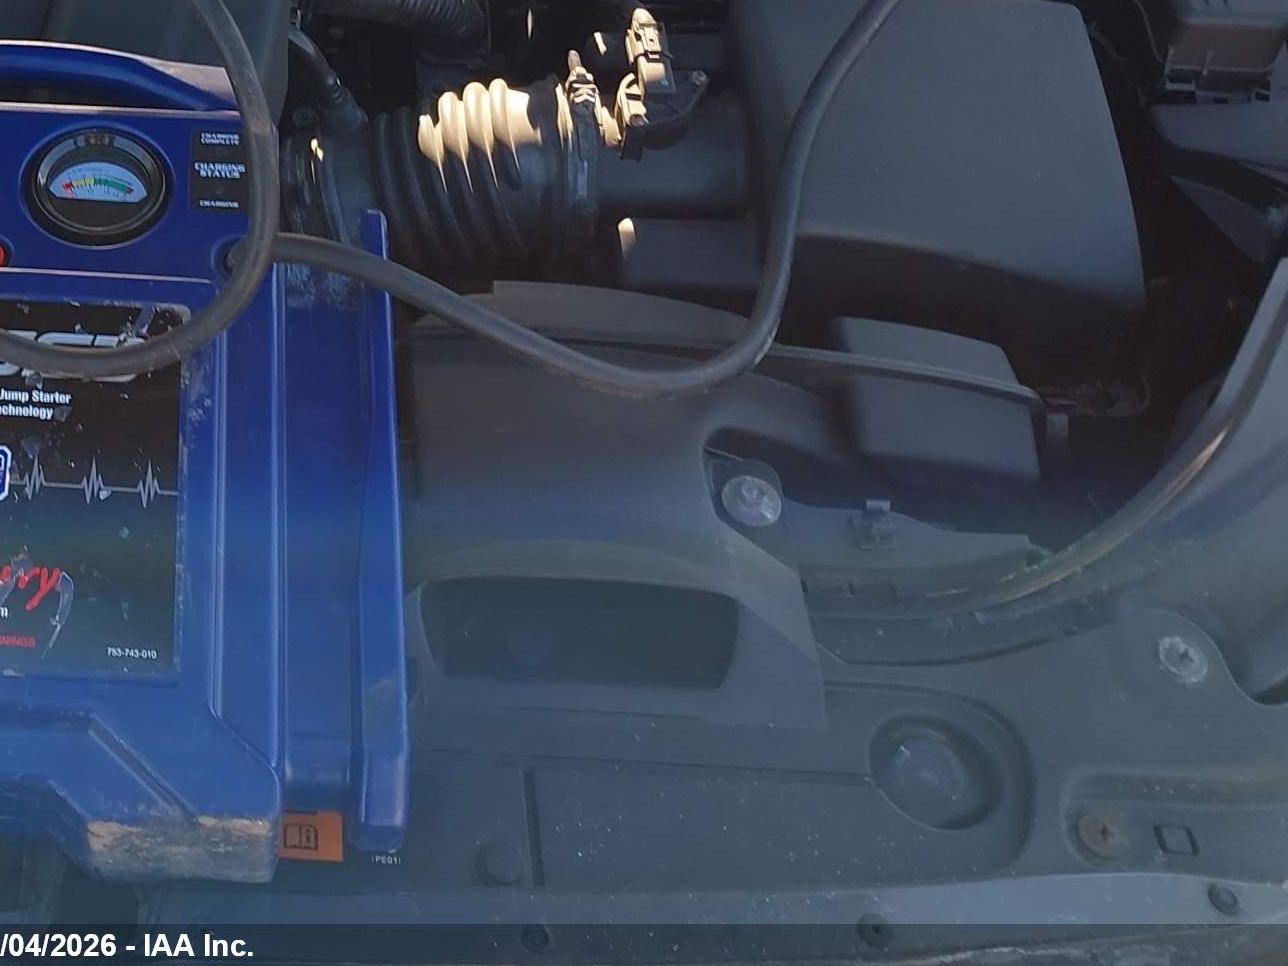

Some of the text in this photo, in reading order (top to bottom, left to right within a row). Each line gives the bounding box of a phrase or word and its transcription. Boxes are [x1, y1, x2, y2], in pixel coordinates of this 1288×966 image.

[194, 161, 246, 173] CHARGING
[199, 169, 240, 179] STATUS
[31, 390, 72, 404] Starter
